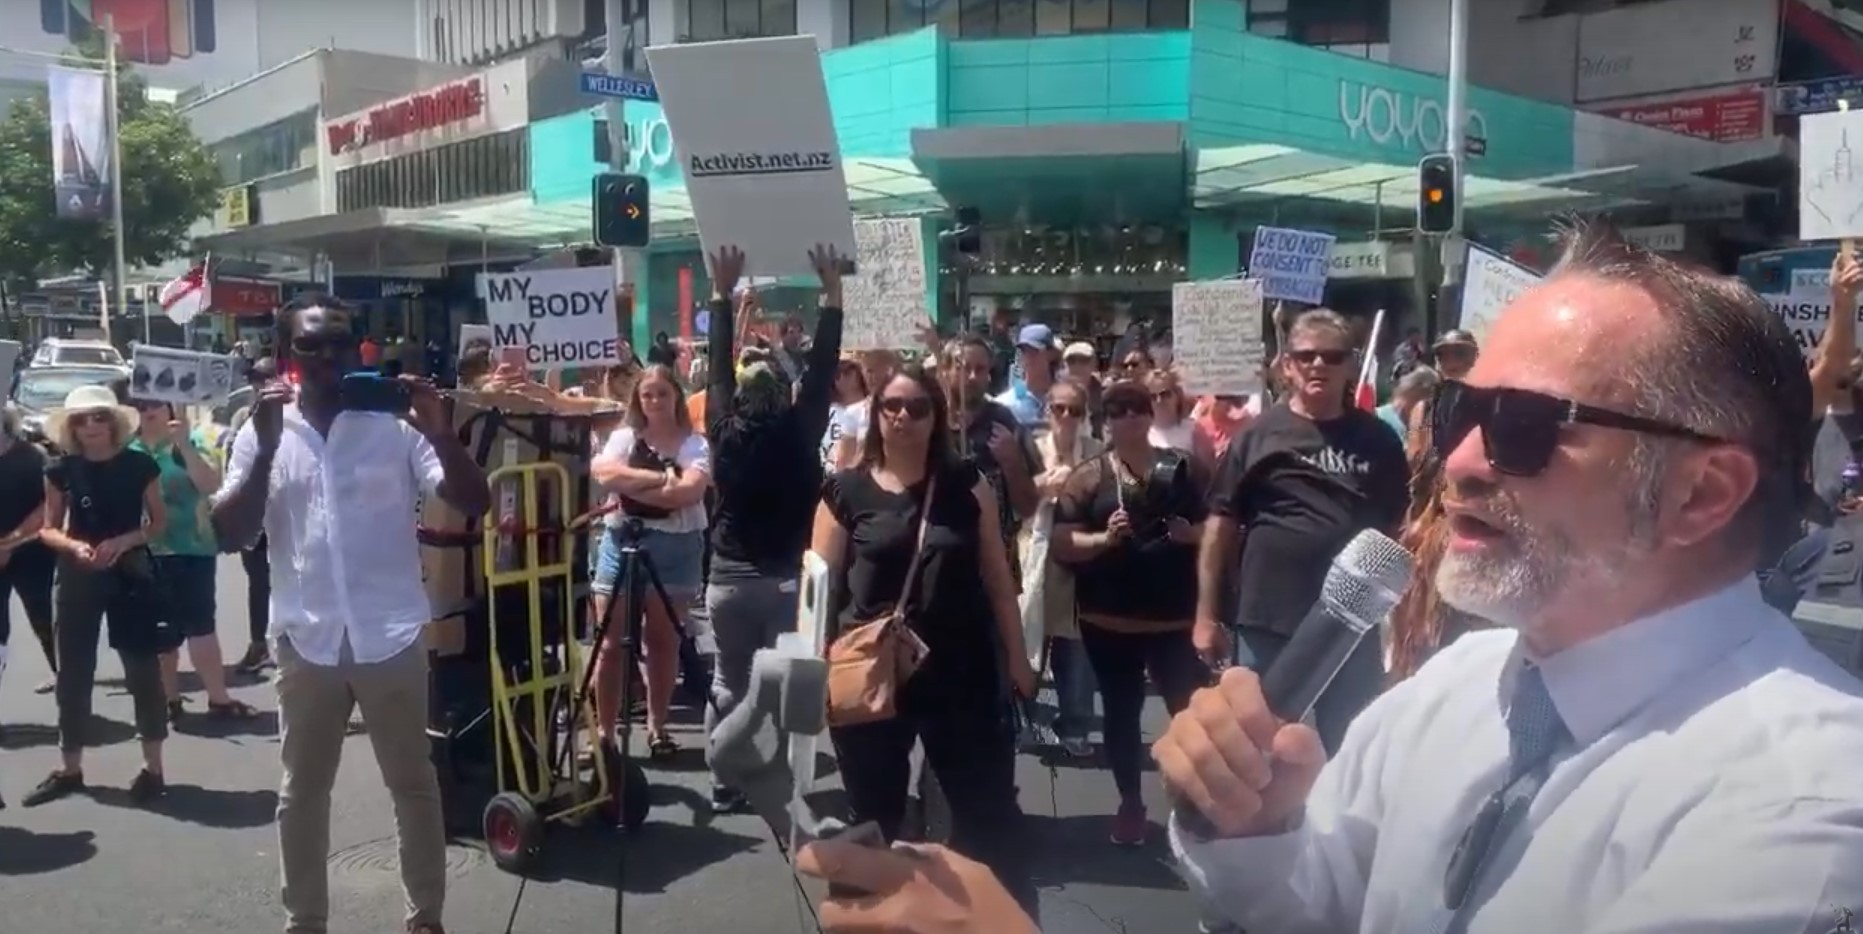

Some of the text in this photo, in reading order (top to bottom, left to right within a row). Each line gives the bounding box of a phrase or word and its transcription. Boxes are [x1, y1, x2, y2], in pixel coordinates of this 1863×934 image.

[587, 76, 653, 97] WELLESLEY
[691, 152, 833, 173] Activist.net.nz
[1254, 250, 1314, 274] CONSENT
[488, 276, 531, 302] MY
[528, 289, 609, 318] BODY
[494, 321, 535, 346] MY
[525, 340, 617, 363] CHOICE
